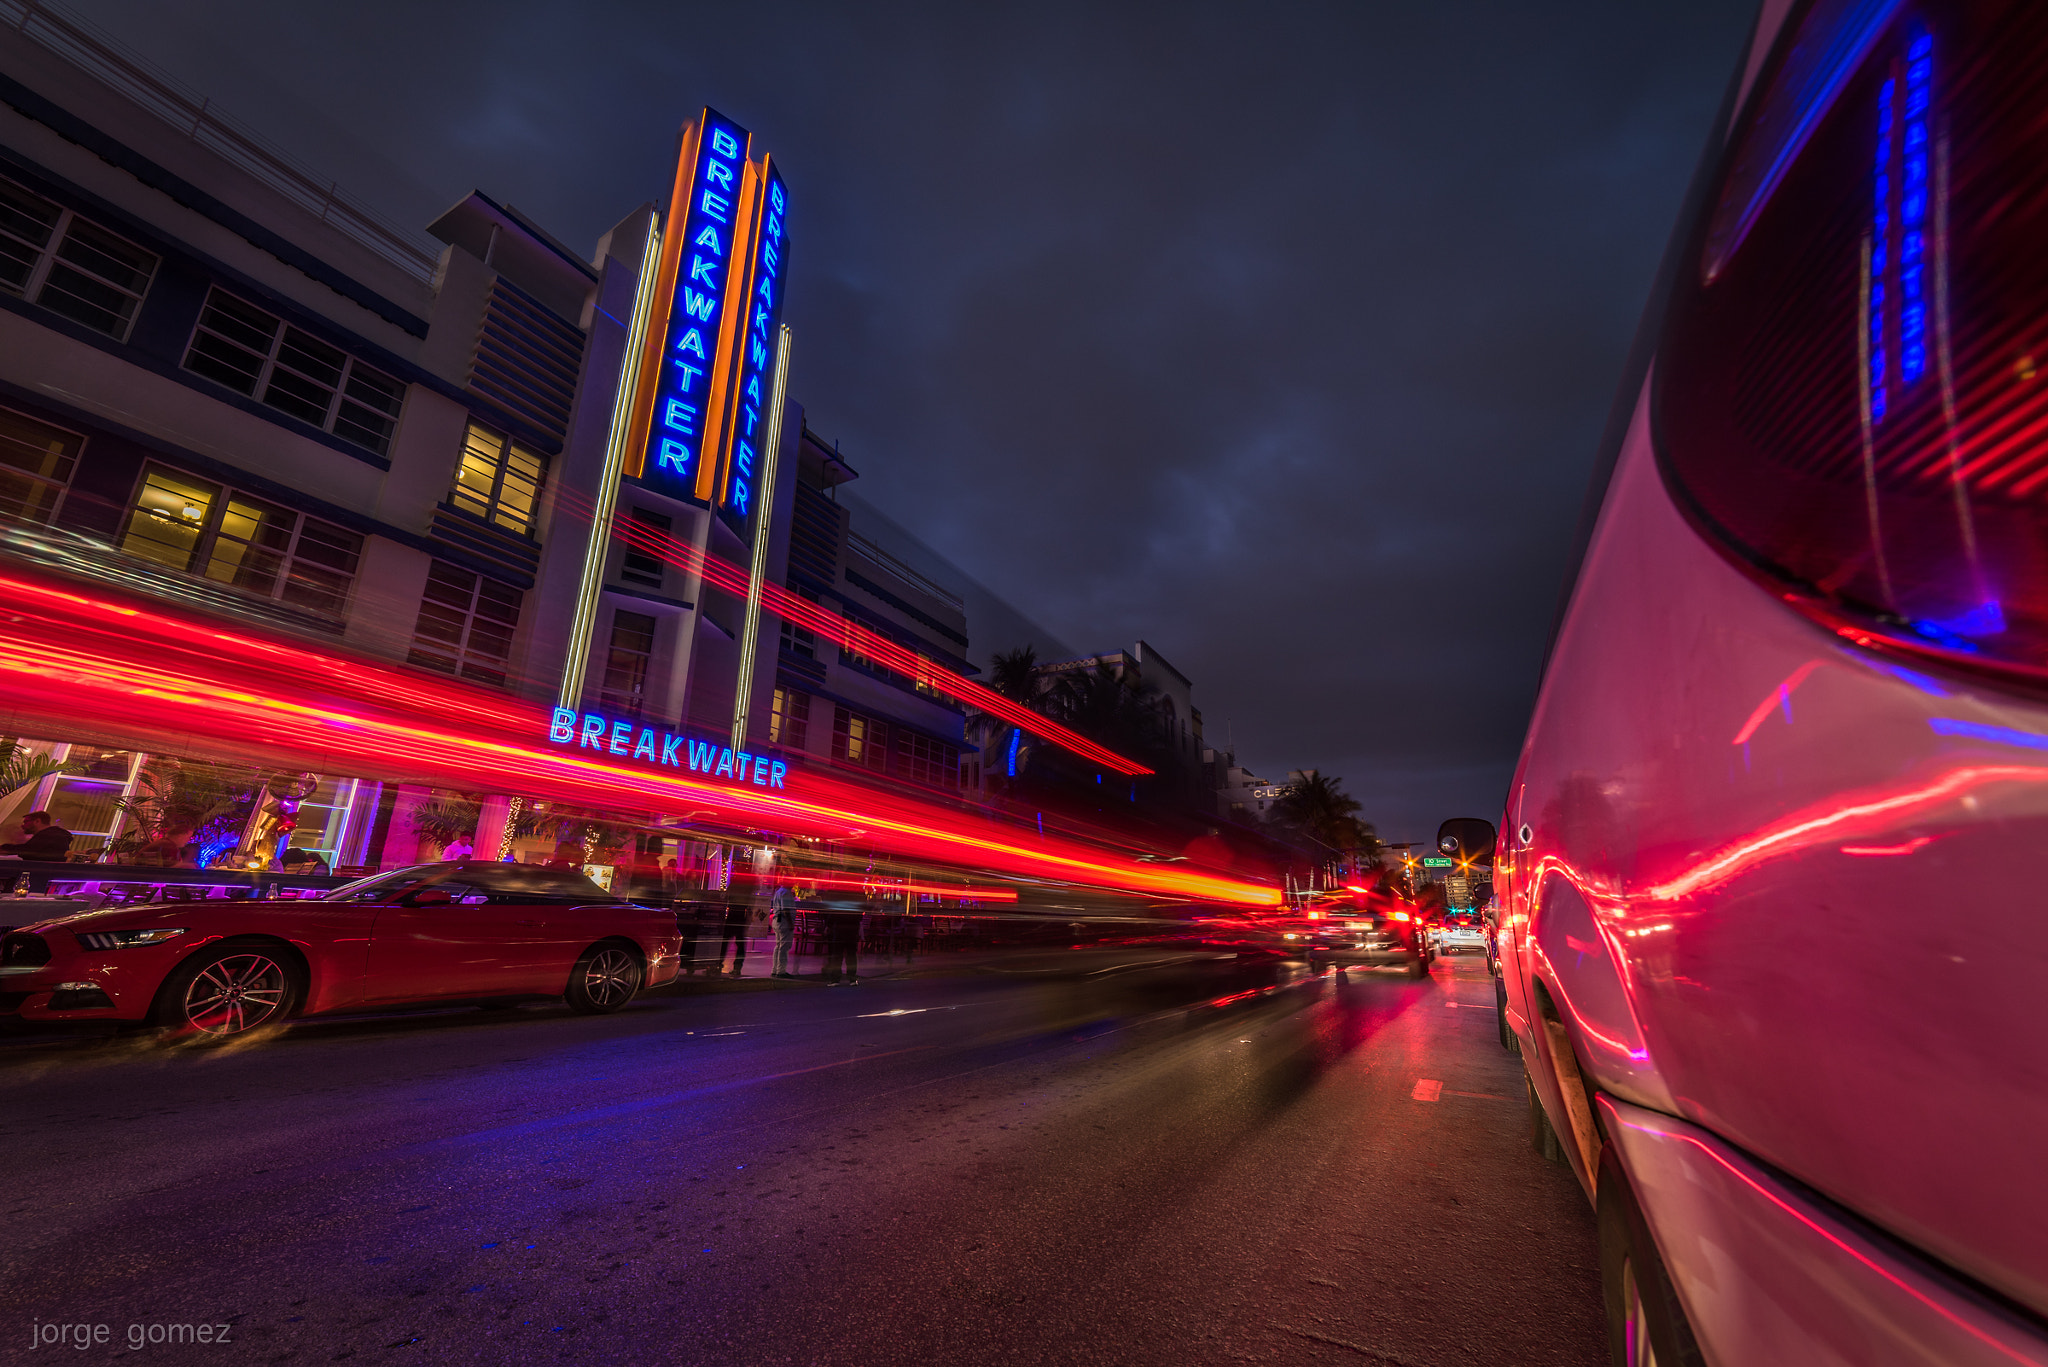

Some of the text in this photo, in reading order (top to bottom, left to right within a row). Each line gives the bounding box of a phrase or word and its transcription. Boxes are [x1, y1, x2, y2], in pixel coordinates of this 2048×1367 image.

[657, 126, 738, 476] BREAKWATER
[732, 179, 785, 515] BREAKWATER
[549, 705, 787, 790] BREAKWATER
